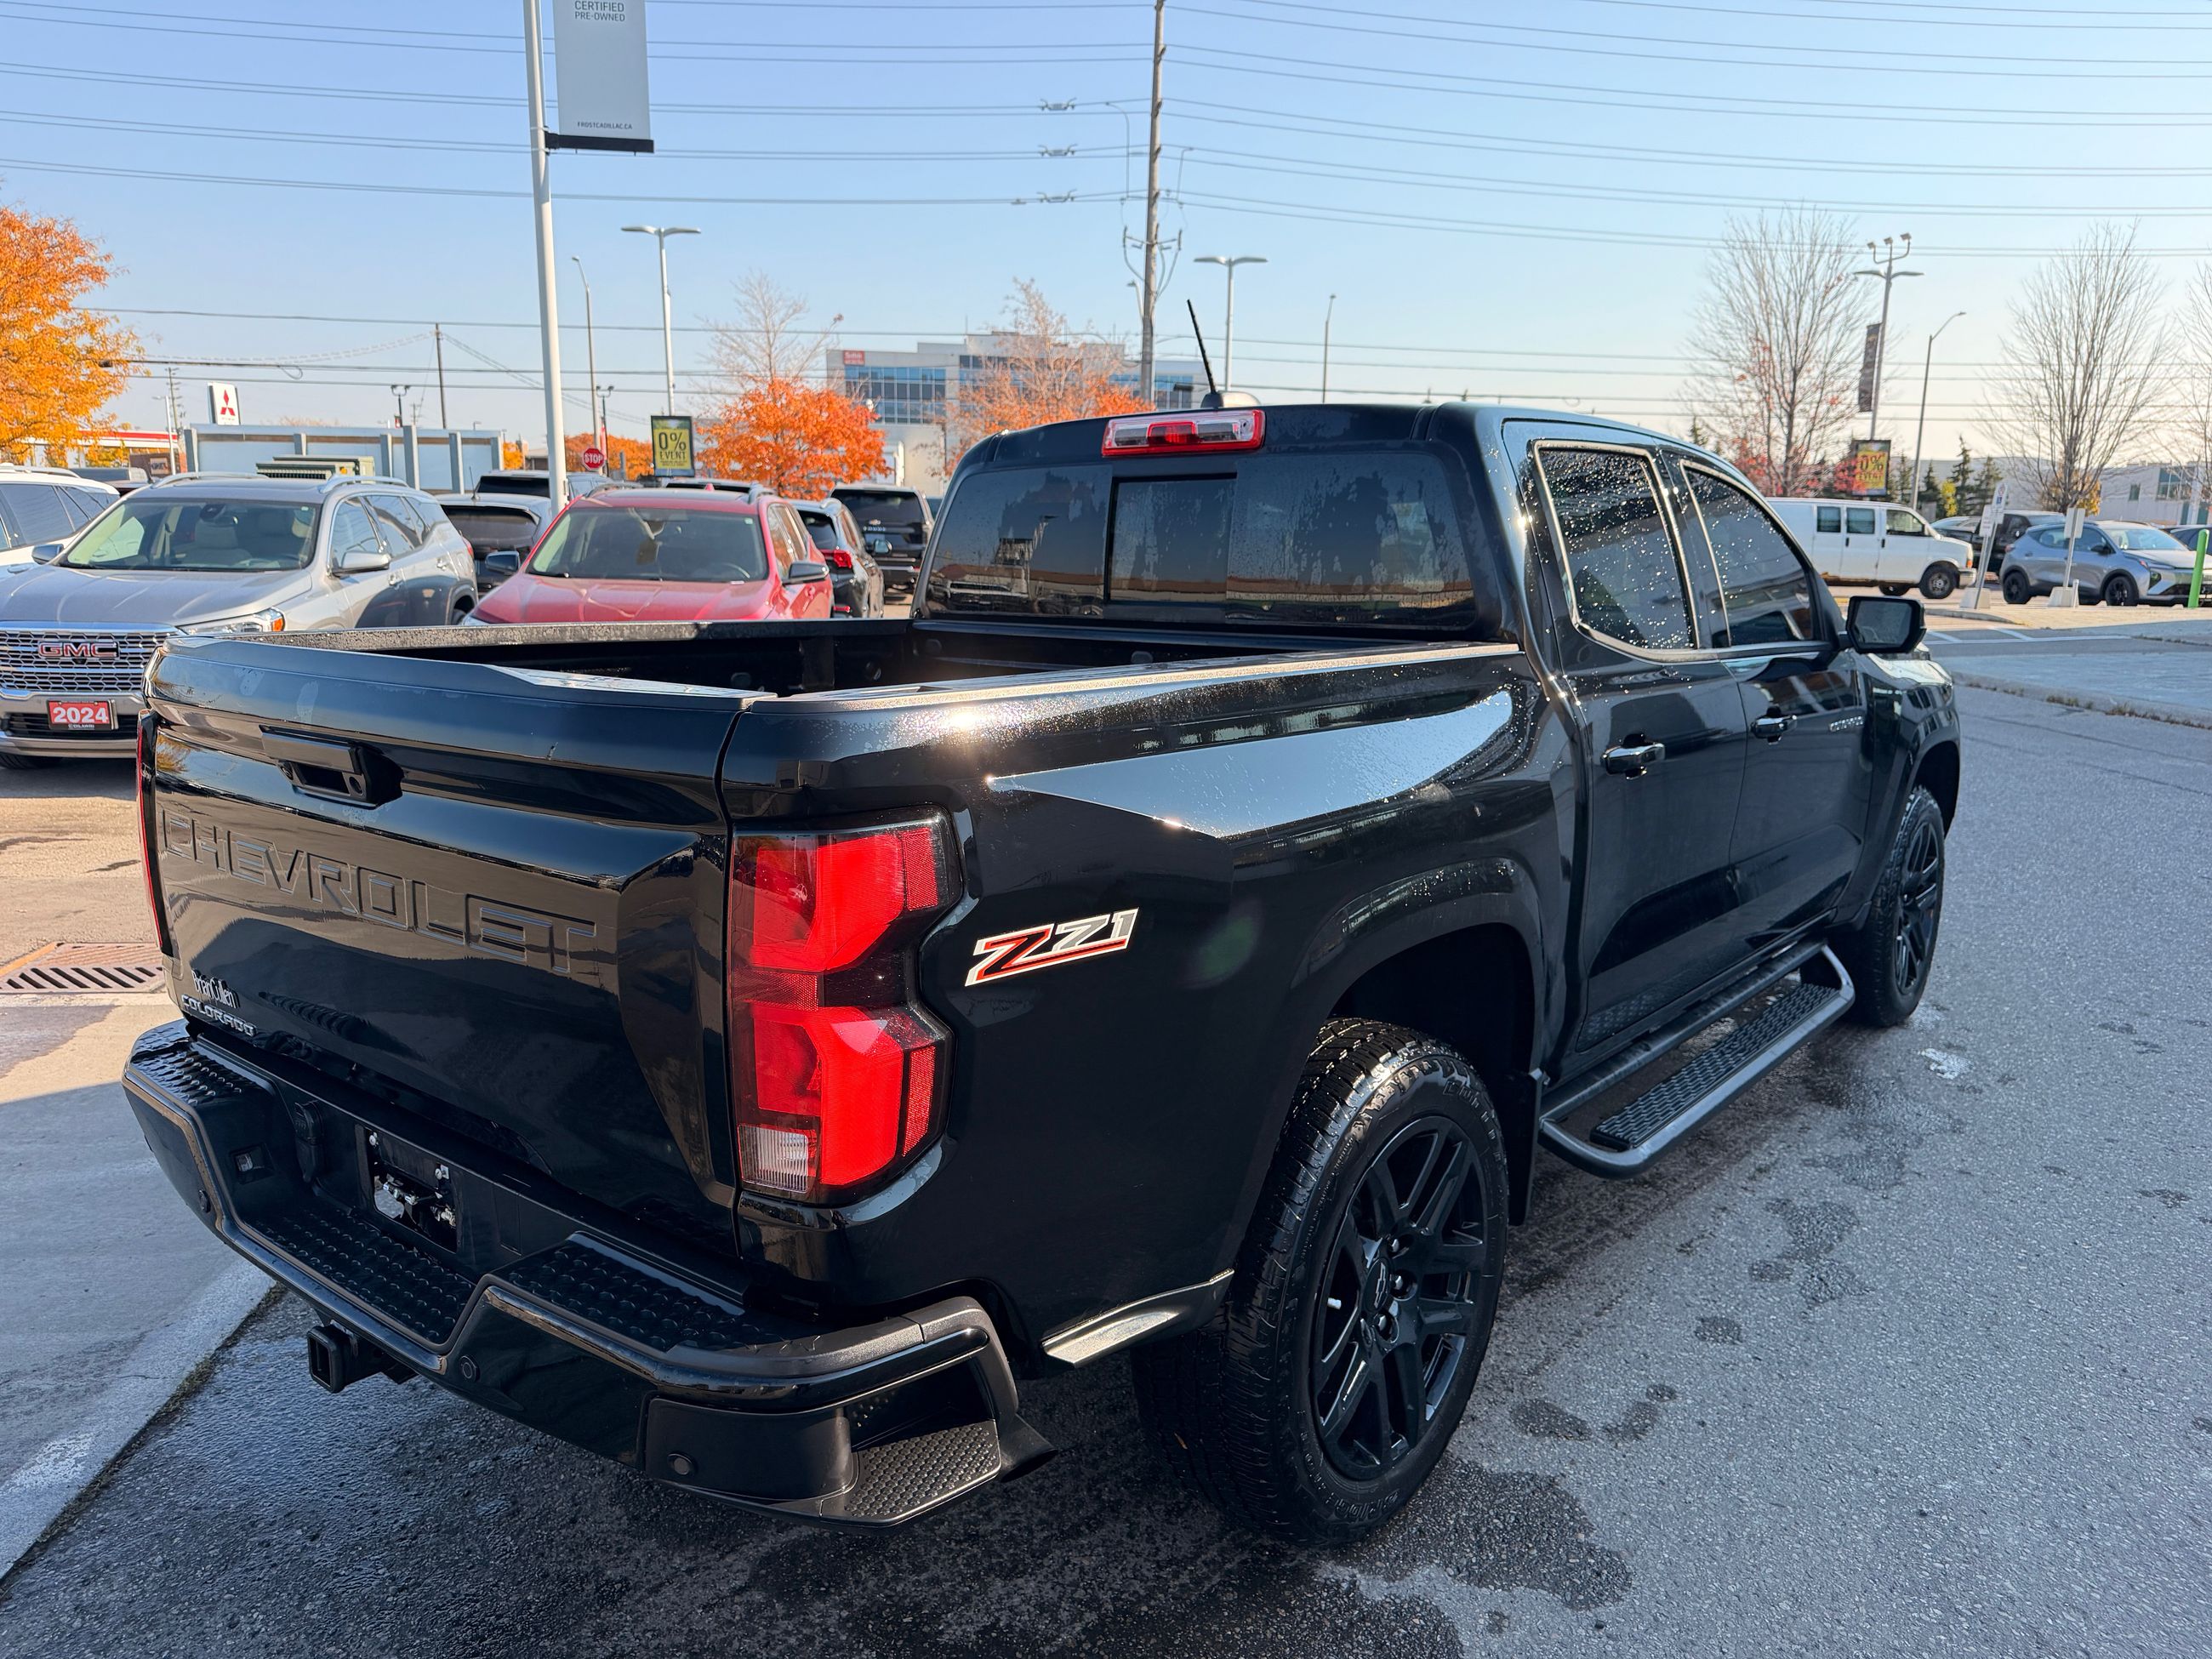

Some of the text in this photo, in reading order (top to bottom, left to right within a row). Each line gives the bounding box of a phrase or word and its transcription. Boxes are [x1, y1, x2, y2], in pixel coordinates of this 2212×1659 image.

[574, 1, 624, 12] CERTIFIED
[574, 11, 625, 21] PRE-OWNED
[578, 122, 633, 130] FROSTCADILLAC.CA
[658, 432, 687, 451] 0%
[584, 453, 603, 464] STOP
[659, 451, 686, 460] EVENT
[39, 642, 117, 657] GMC
[53, 707, 109, 723] 2024
[162, 809, 596, 973] CHEVROLET
[964, 907, 1140, 987] Z71
[180, 994, 257, 1037] COLORADO
